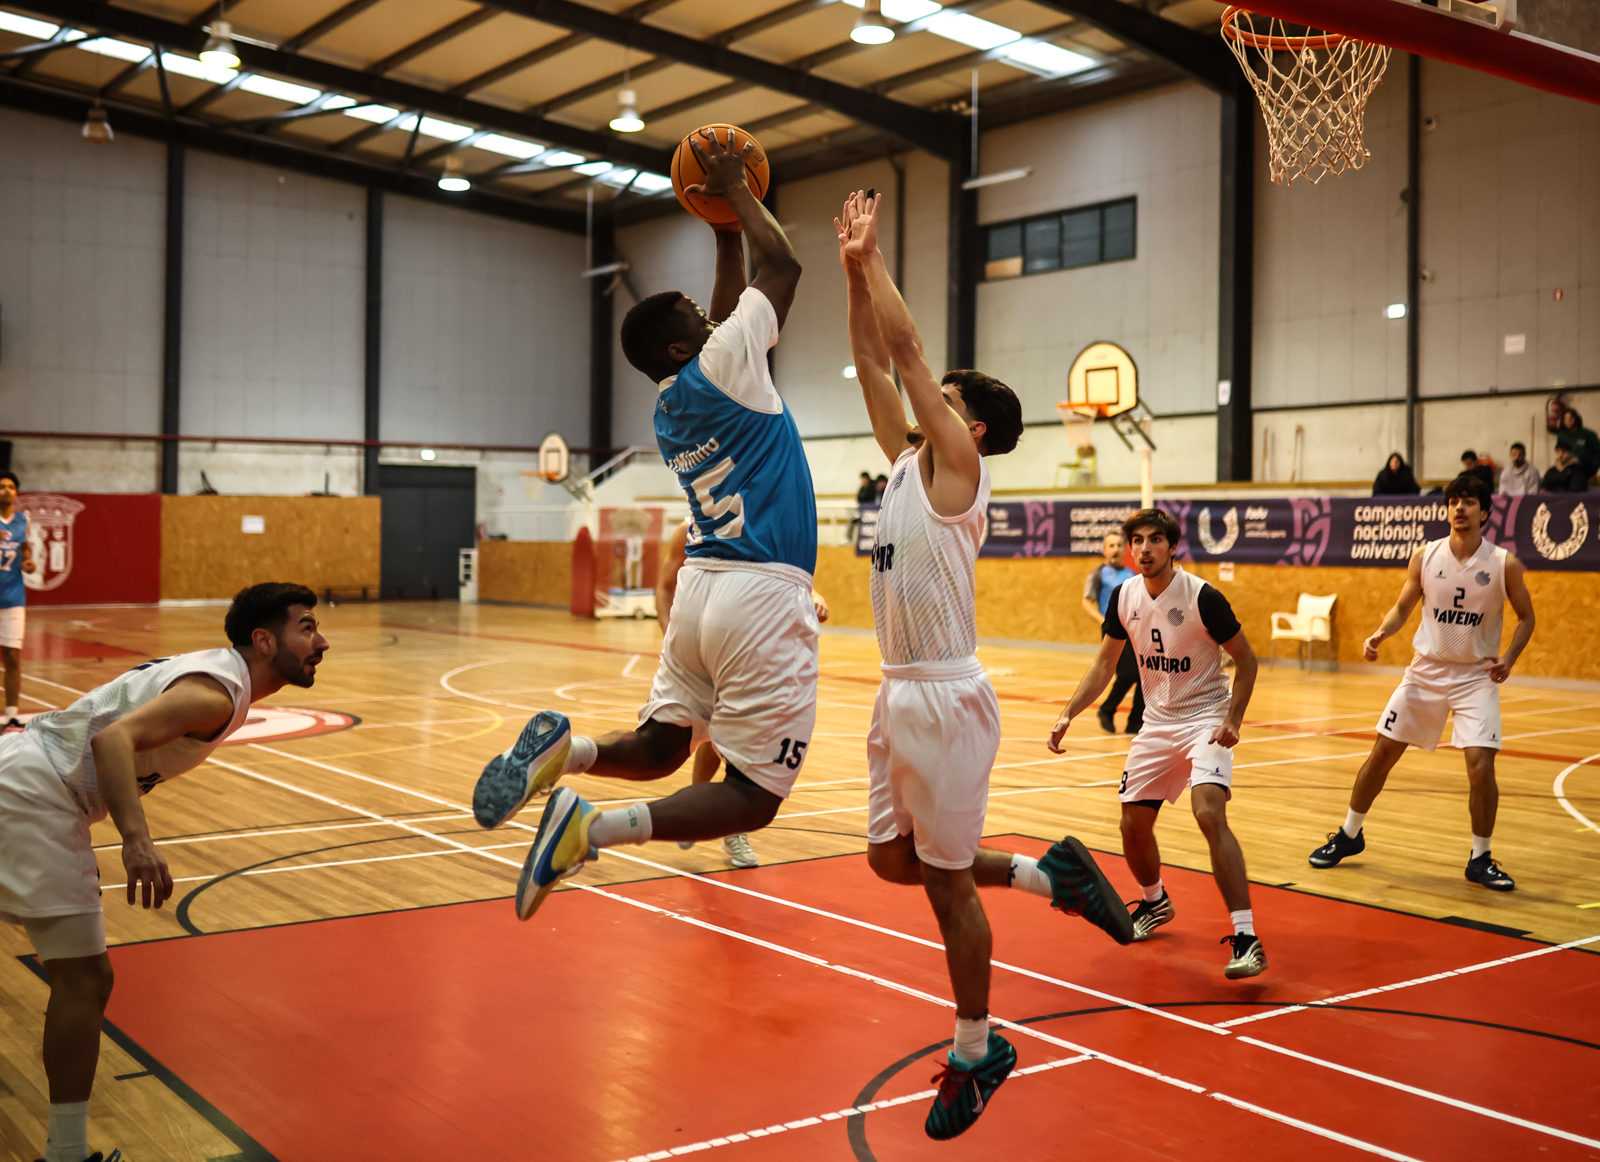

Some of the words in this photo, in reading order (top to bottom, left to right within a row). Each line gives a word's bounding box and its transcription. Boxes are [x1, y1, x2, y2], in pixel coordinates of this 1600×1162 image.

[1354, 502, 1448, 525] campeonato
[1353, 521, 1425, 541] nacionais
[1350, 539, 1427, 560] universit
[1453, 587, 1466, 609] 2
[1151, 628, 1165, 653] 9
[1384, 710, 1398, 732] 2
[772, 737, 808, 771] 15
